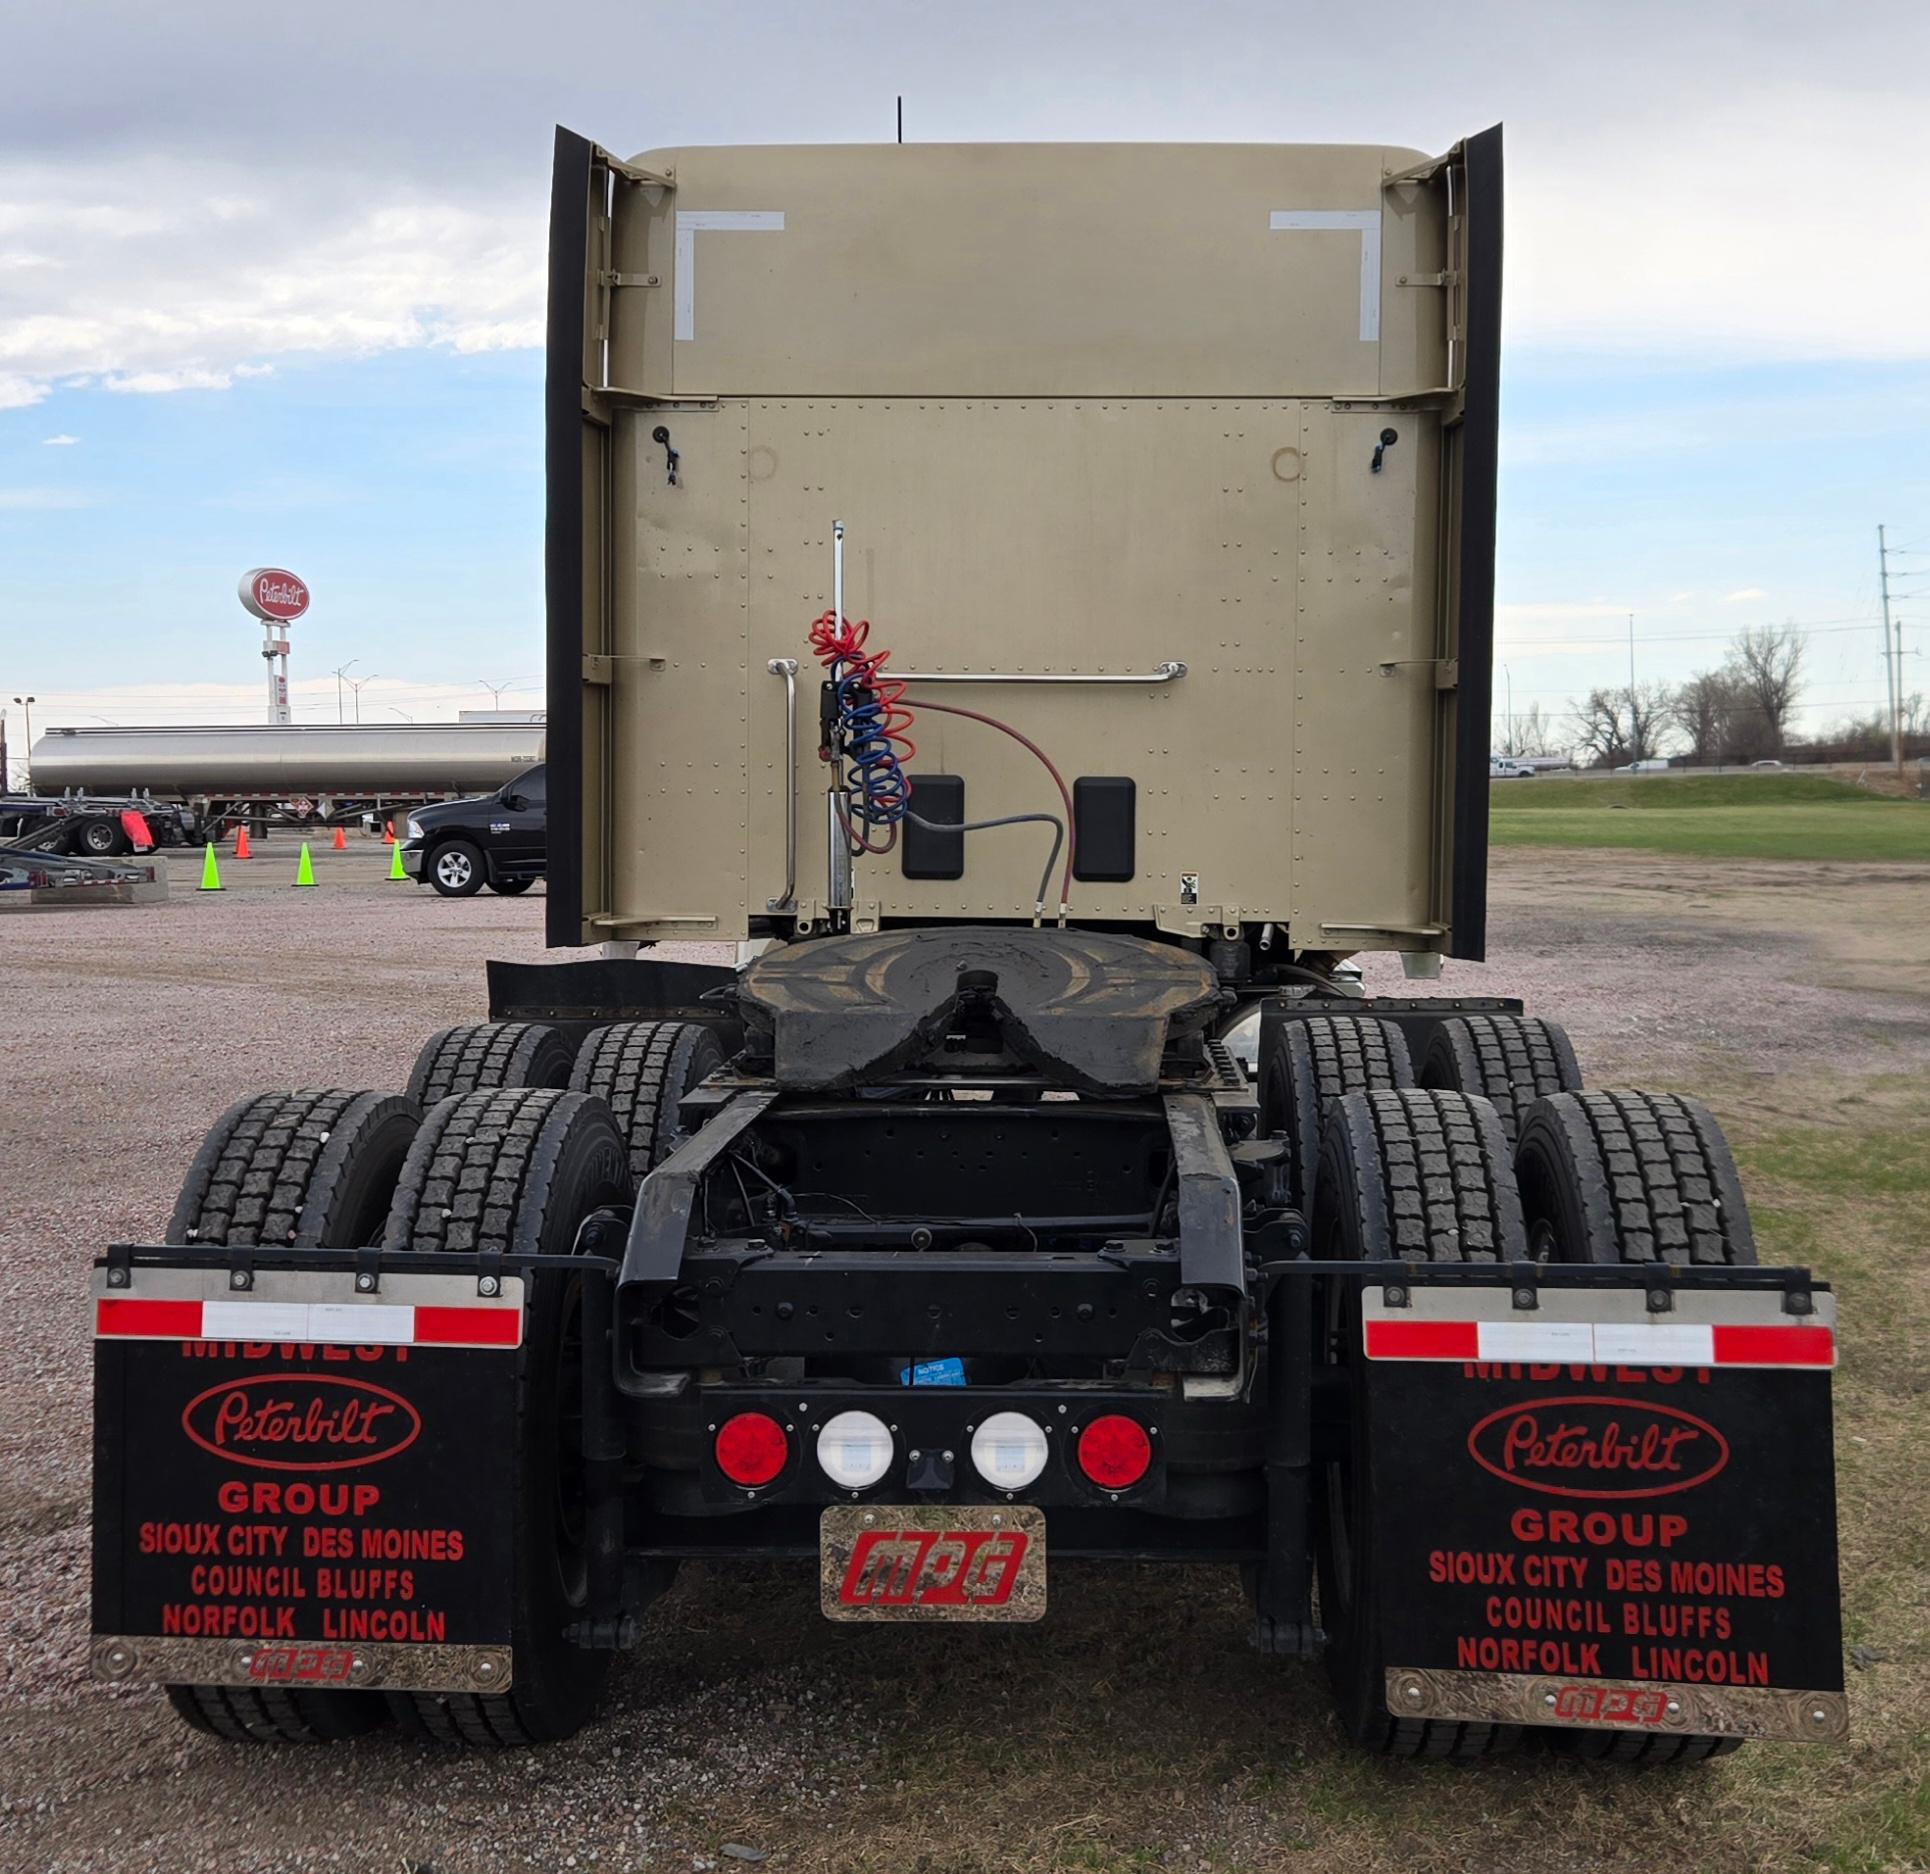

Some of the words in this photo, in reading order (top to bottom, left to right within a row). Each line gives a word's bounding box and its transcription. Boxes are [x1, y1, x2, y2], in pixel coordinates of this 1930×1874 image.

[258, 578, 305, 607] Peterbilt
[215, 1391, 395, 1446] Peterbilt
[1503, 1415, 1700, 1473] Peterbilt
[218, 1481, 381, 1516] GROUP
[140, 1523, 221, 1555] SIOUX
[227, 1525, 288, 1557] CITY
[303, 1526, 354, 1558] DES
[362, 1528, 465, 1561] MOINES
[1511, 1509, 1688, 1547] GROUP
[191, 1564, 306, 1598] COUNCIL
[316, 1568, 415, 1600] BLUFFS
[846, 1535, 1024, 1603] MPG
[1429, 1552, 1514, 1585] SIOUX
[1523, 1555, 1588, 1589] CITY
[1606, 1559, 1661, 1593] DES
[1671, 1562, 1785, 1598] MOINES
[162, 1604, 296, 1638] NORFOLK
[323, 1608, 446, 1642] LINCOLN
[1486, 1597, 1611, 1633] COUNCIL
[1623, 1603, 1732, 1639] BLUFFS
[252, 1650, 349, 1678] MPG
[1457, 1637, 1600, 1674] NORFOLK
[1632, 1647, 1769, 1685] LINCOLN
[1557, 1688, 1664, 1720] MPG
